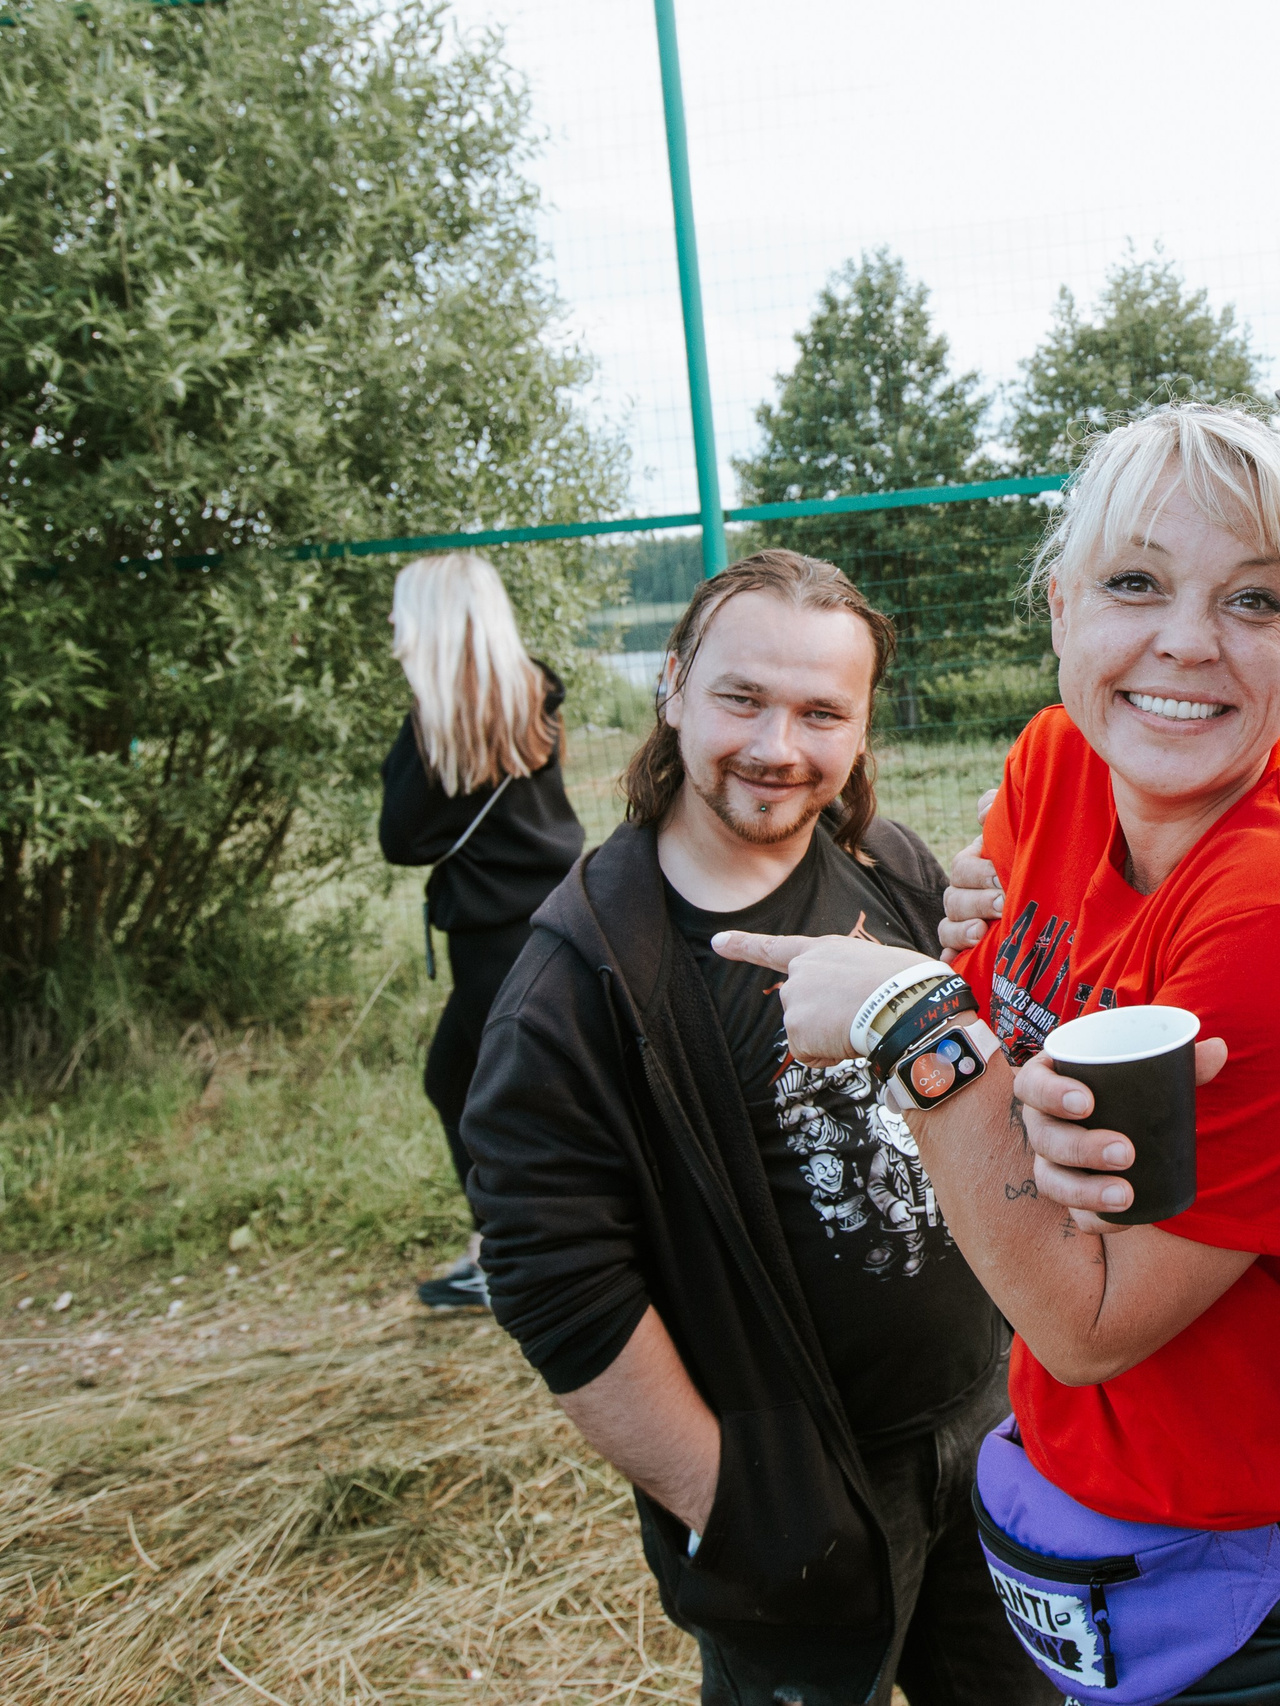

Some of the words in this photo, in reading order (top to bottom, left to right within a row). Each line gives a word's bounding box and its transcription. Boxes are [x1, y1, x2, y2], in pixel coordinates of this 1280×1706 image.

[1014, 989, 1031, 1010] 26
[1024, 1002, 1056, 1033] ИЮНЯ
[919, 1077, 934, 1095] 19
[930, 1069, 946, 1087] 35
